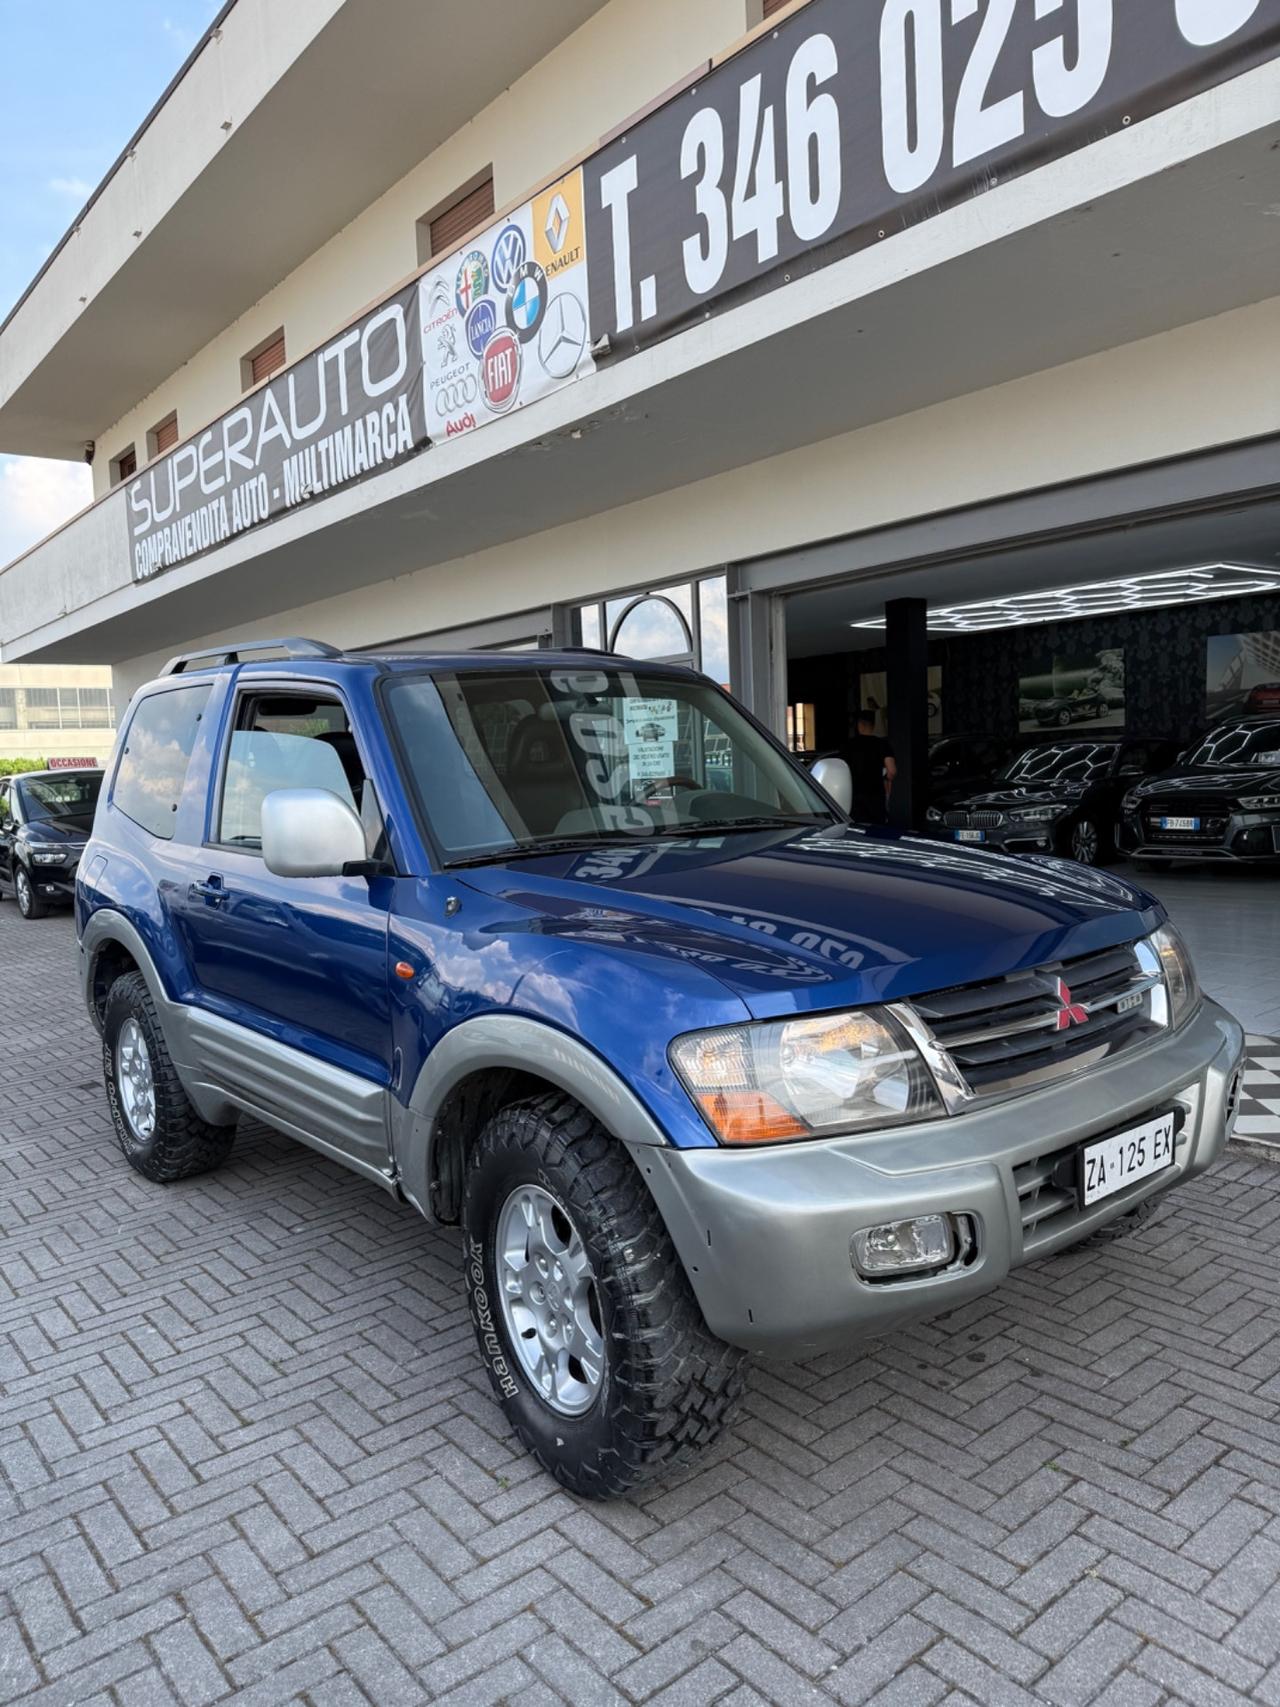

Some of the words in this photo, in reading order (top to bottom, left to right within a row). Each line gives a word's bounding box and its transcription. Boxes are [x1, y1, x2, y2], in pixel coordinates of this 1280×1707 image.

[601, 154, 657, 334] T.
[680, 33, 842, 295] 346
[545, 246, 581, 277] ENAULT
[429, 362, 471, 389] PEUGEOT
[487, 346, 514, 393] FIAT
[131, 303, 408, 536] SUPERAUTO
[446, 412, 477, 436] Audi
[135, 495, 230, 579] COMPRAVENDITA
[232, 472, 269, 533] AUTO
[283, 393, 414, 507] MULTIMARCA
[1153, 1125, 1172, 1161] EX
